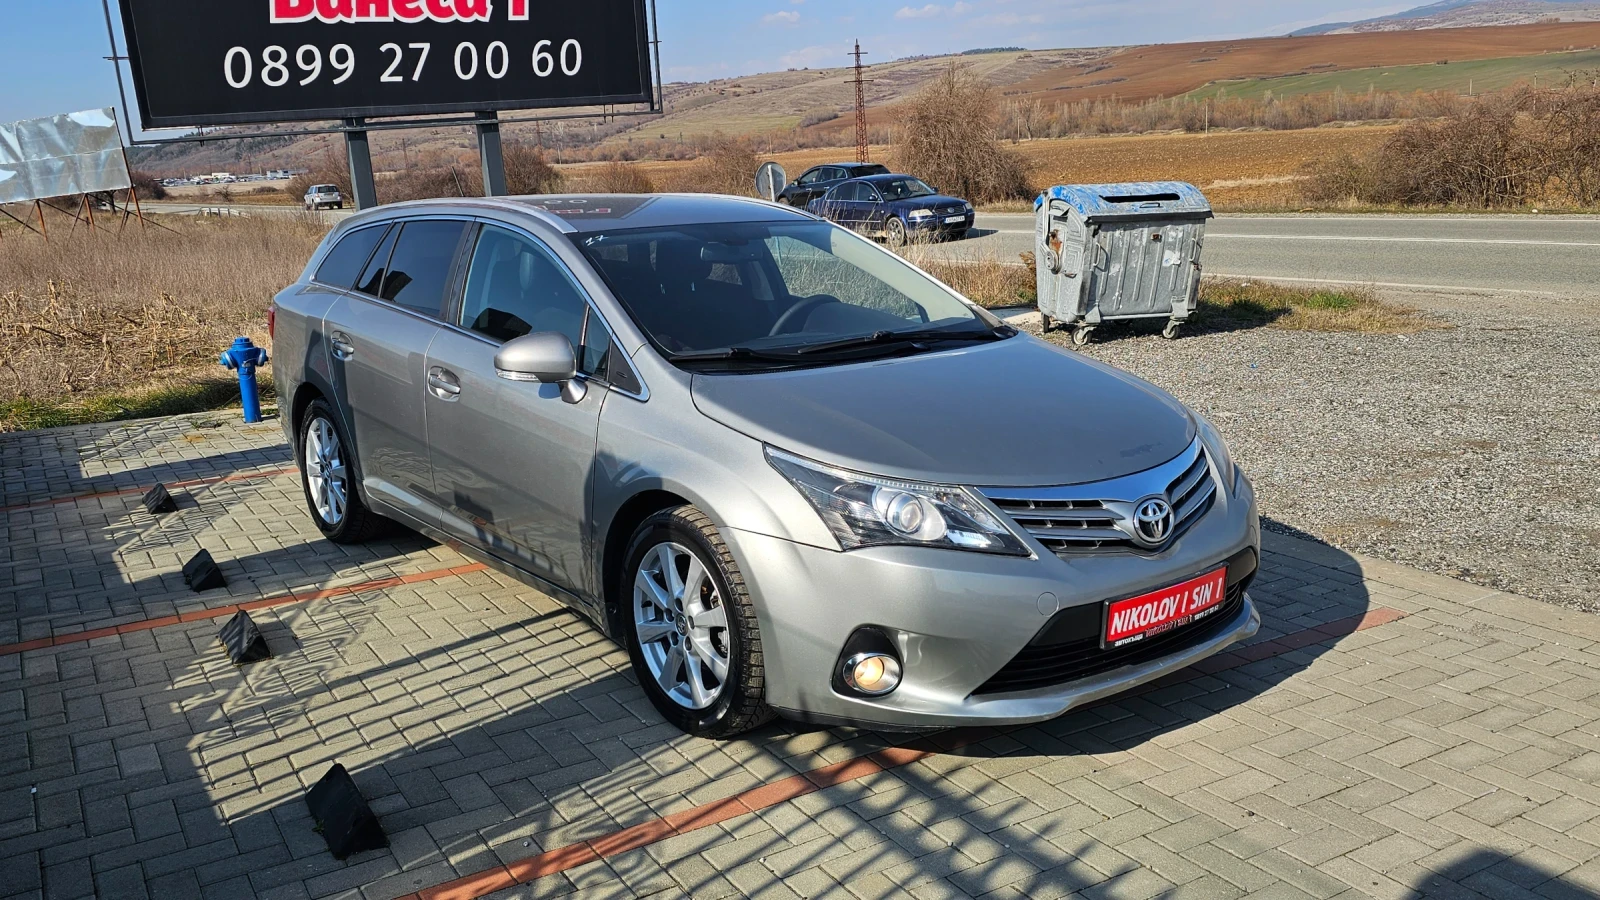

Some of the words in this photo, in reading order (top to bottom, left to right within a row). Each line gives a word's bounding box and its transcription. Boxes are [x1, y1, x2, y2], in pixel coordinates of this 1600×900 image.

[223, 43, 356, 88] 0899
[379, 42, 431, 82] 27
[454, 41, 509, 80] 00
[531, 39, 582, 77] 60
[1110, 593, 1181, 636] NIKOLOV
[1190, 582, 1213, 610] SIN
[1215, 577, 1223, 599] 1
